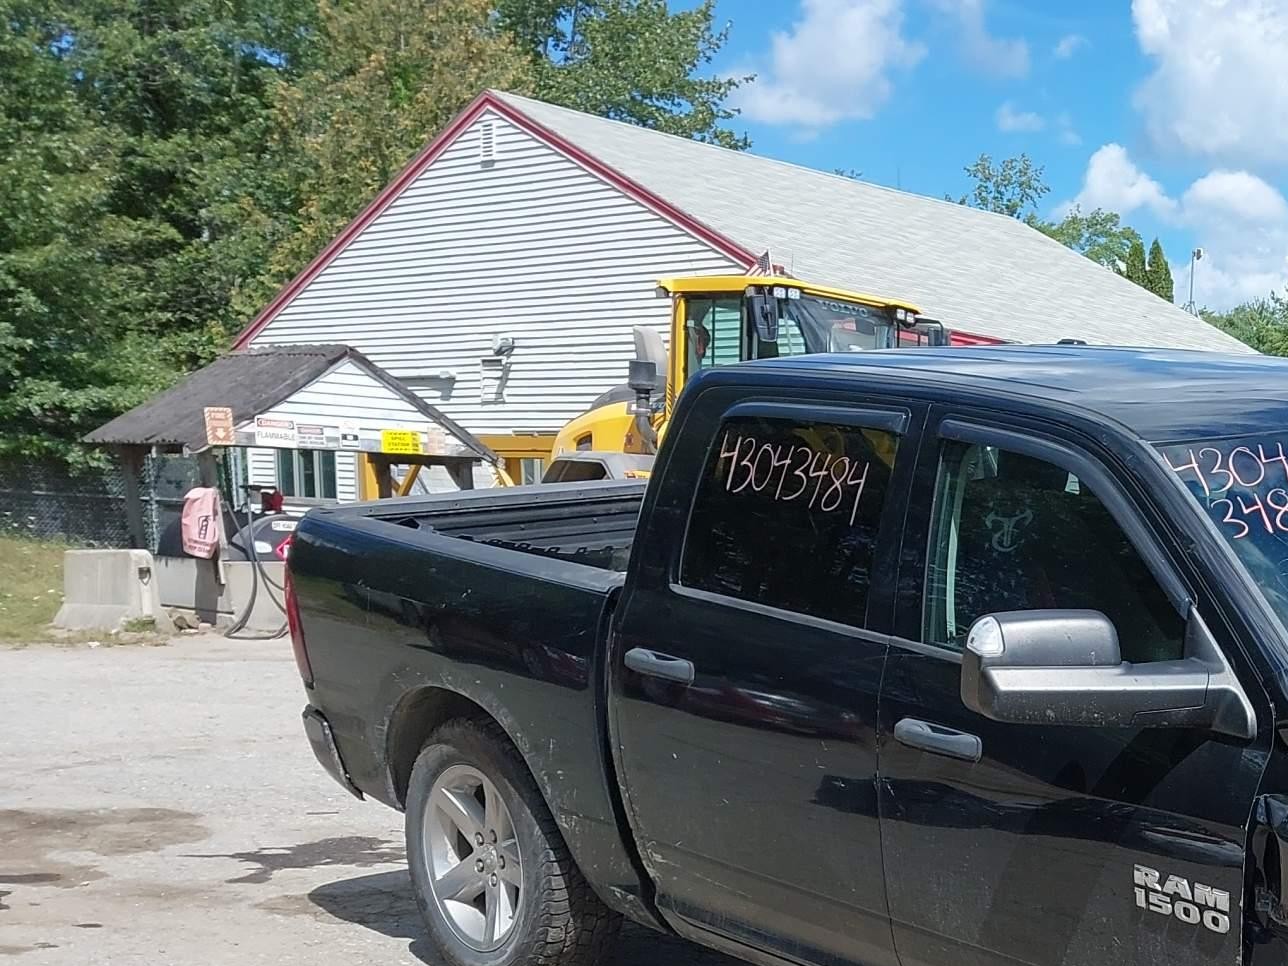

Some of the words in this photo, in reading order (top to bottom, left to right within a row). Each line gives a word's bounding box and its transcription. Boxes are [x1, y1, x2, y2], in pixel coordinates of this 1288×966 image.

[815, 300, 869, 318] VOLVO
[719, 431, 869, 527] 43043484
[1133, 863, 1230, 912] RAM
[1134, 886, 1230, 934] 1500
